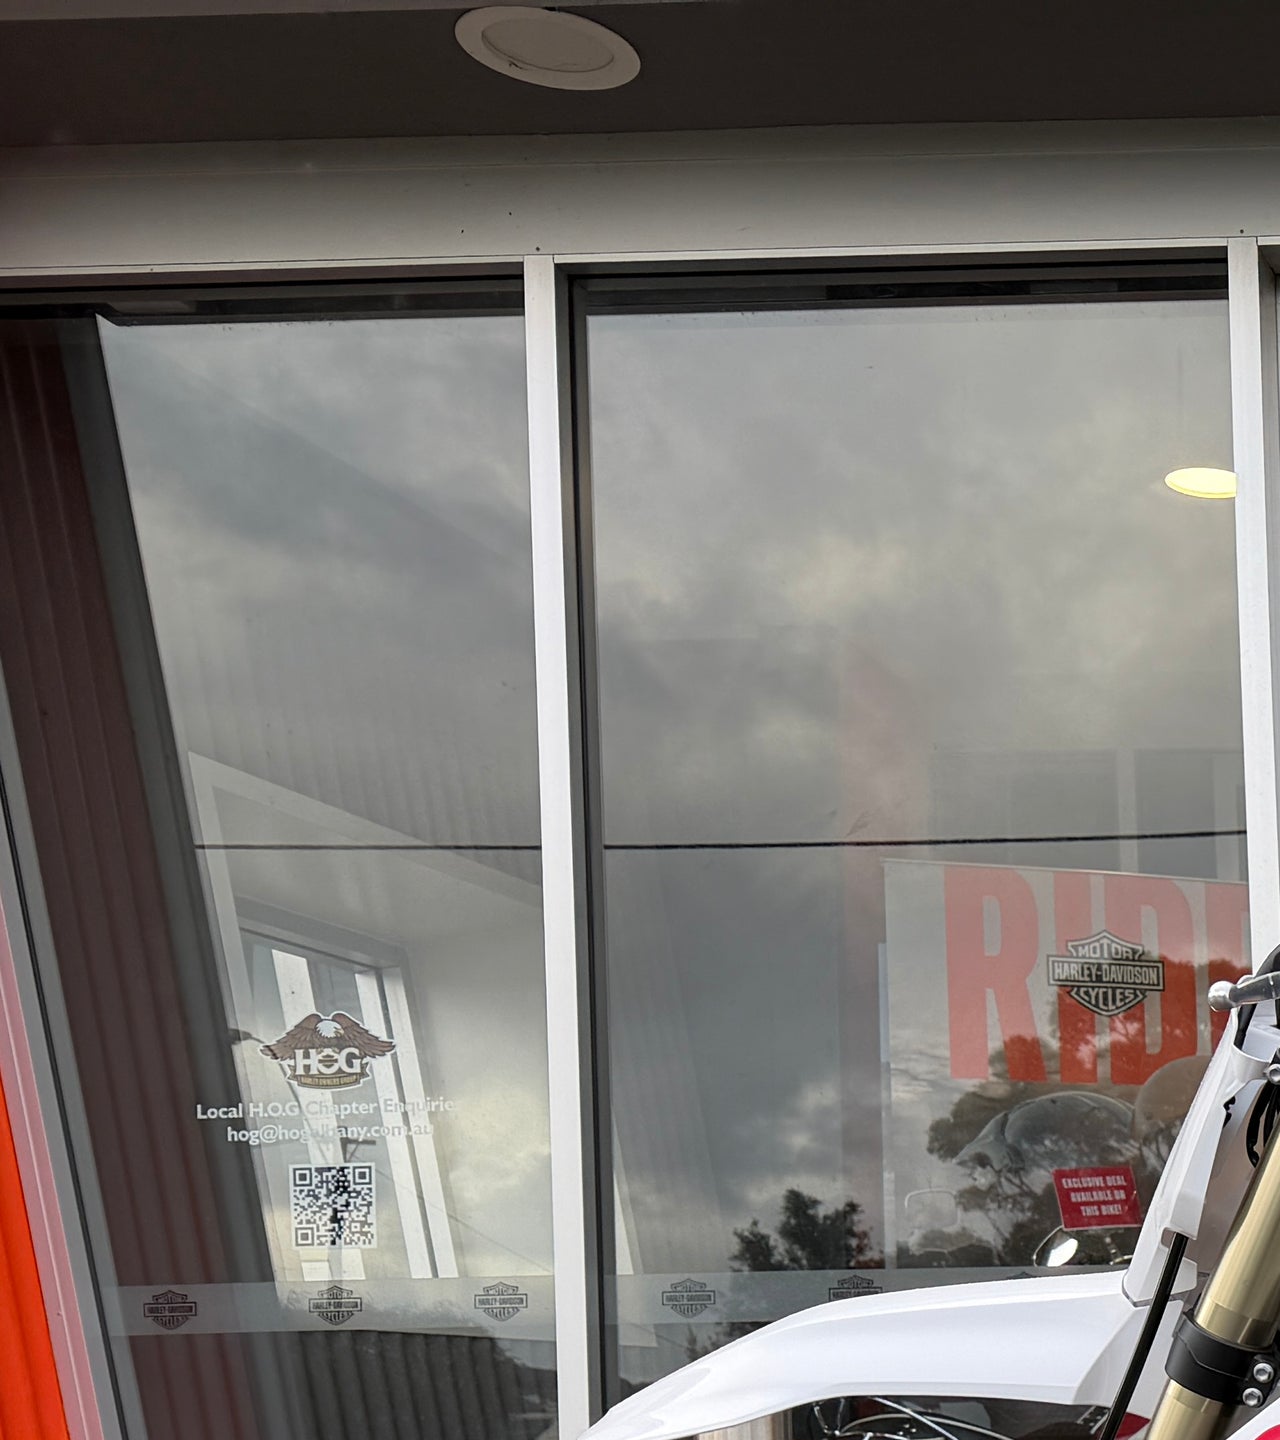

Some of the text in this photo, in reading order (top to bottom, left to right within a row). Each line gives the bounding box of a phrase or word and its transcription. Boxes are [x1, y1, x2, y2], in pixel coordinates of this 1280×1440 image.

[1078, 939, 1133, 959] MOTOR
[1054, 962, 1158, 984] HARLEY-DAVIDSON
[1080, 987, 1135, 1010] CYCLES
[294, 1047, 363, 1076] HOG
[196, 1103, 243, 1119] Local
[249, 1102, 300, 1118] H.O.G
[383, 1097, 458, 1115] Enquirie
